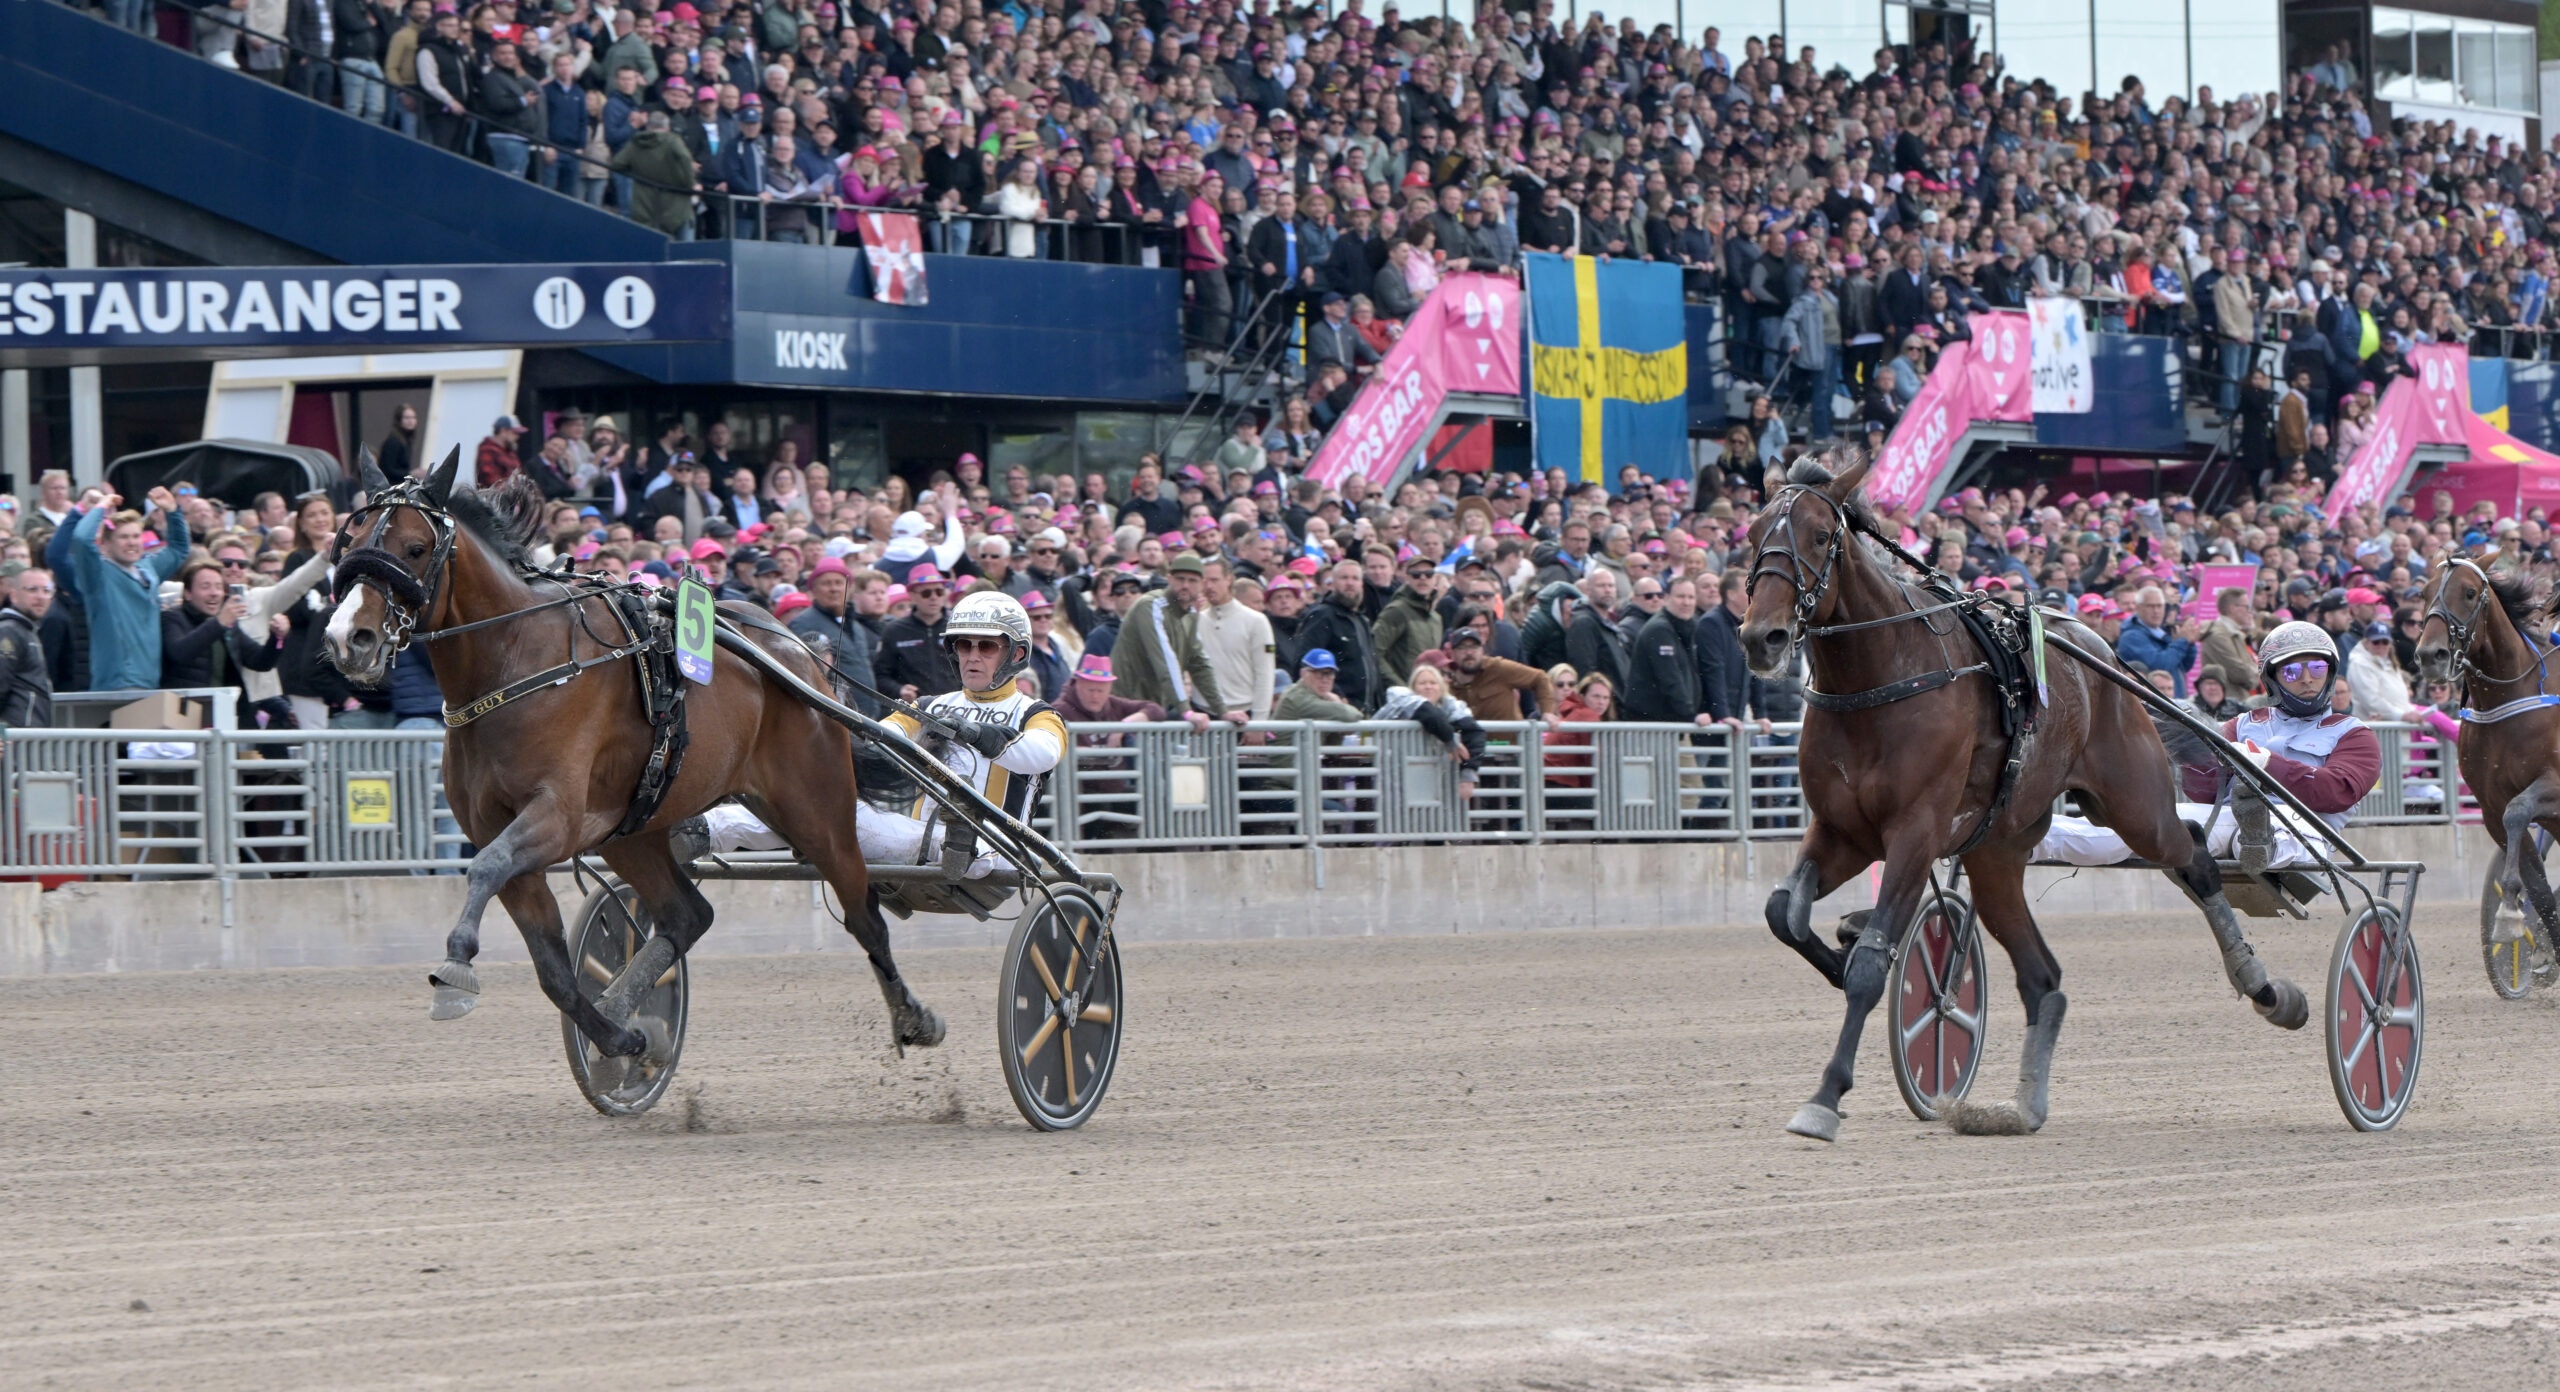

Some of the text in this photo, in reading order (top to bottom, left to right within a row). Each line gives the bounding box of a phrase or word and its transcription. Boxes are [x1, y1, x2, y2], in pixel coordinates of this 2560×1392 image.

[775, 329, 848, 371] KIOSK
[1379, 370, 1424, 444] BAR
[1914, 406, 1948, 472] BAR
[683, 584, 706, 651] 5
[474, 691, 505, 714] GUY
[1006, 816, 1022, 831] BIG
